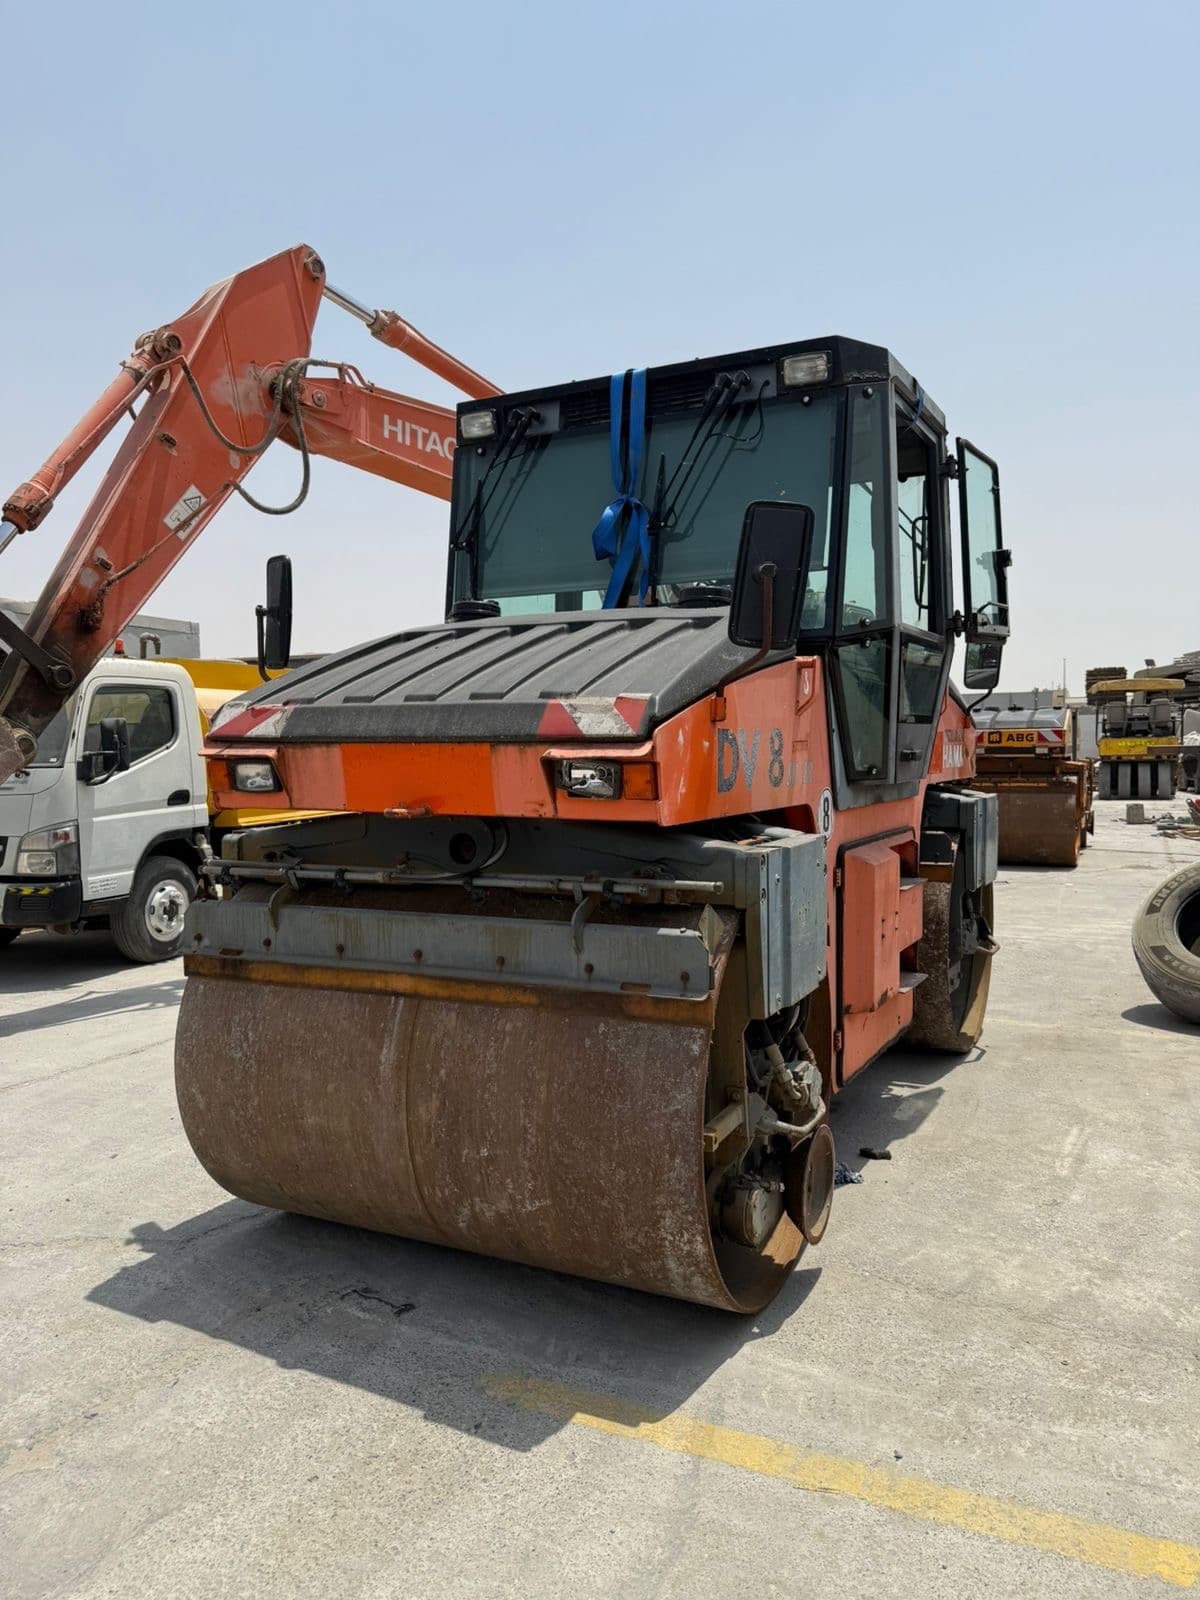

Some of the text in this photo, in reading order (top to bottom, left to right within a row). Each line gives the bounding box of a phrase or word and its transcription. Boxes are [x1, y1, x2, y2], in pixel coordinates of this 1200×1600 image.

[1006, 733, 1034, 743] ABG
[717, 728, 762, 794] DV
[768, 728, 785, 788] 8
[823, 797, 830, 832] 8
